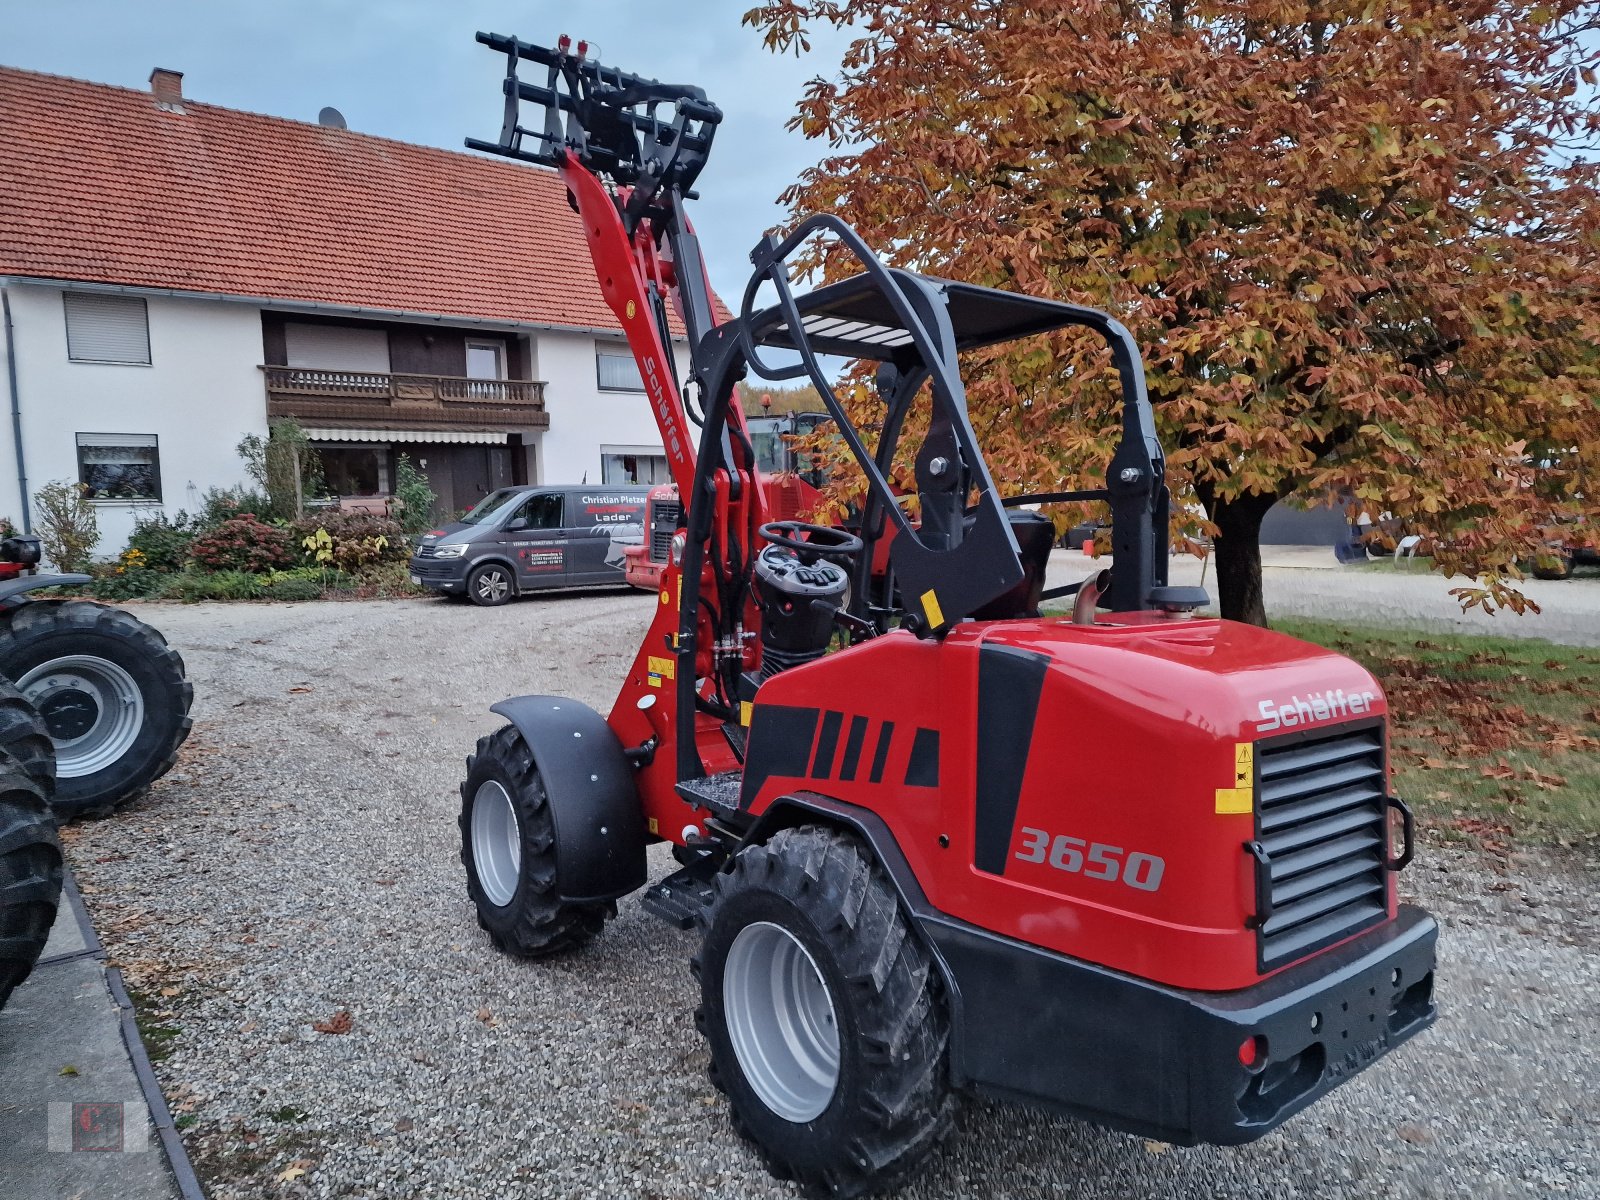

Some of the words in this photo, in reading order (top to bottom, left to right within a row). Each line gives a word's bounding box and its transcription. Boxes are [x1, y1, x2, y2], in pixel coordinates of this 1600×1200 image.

[643, 356, 684, 464] Schäffer
[582, 495, 620, 504] Christian
[595, 513, 632, 522] Lader
[1256, 688, 1376, 733] Schäffer
[1014, 826, 1166, 892] 3650
